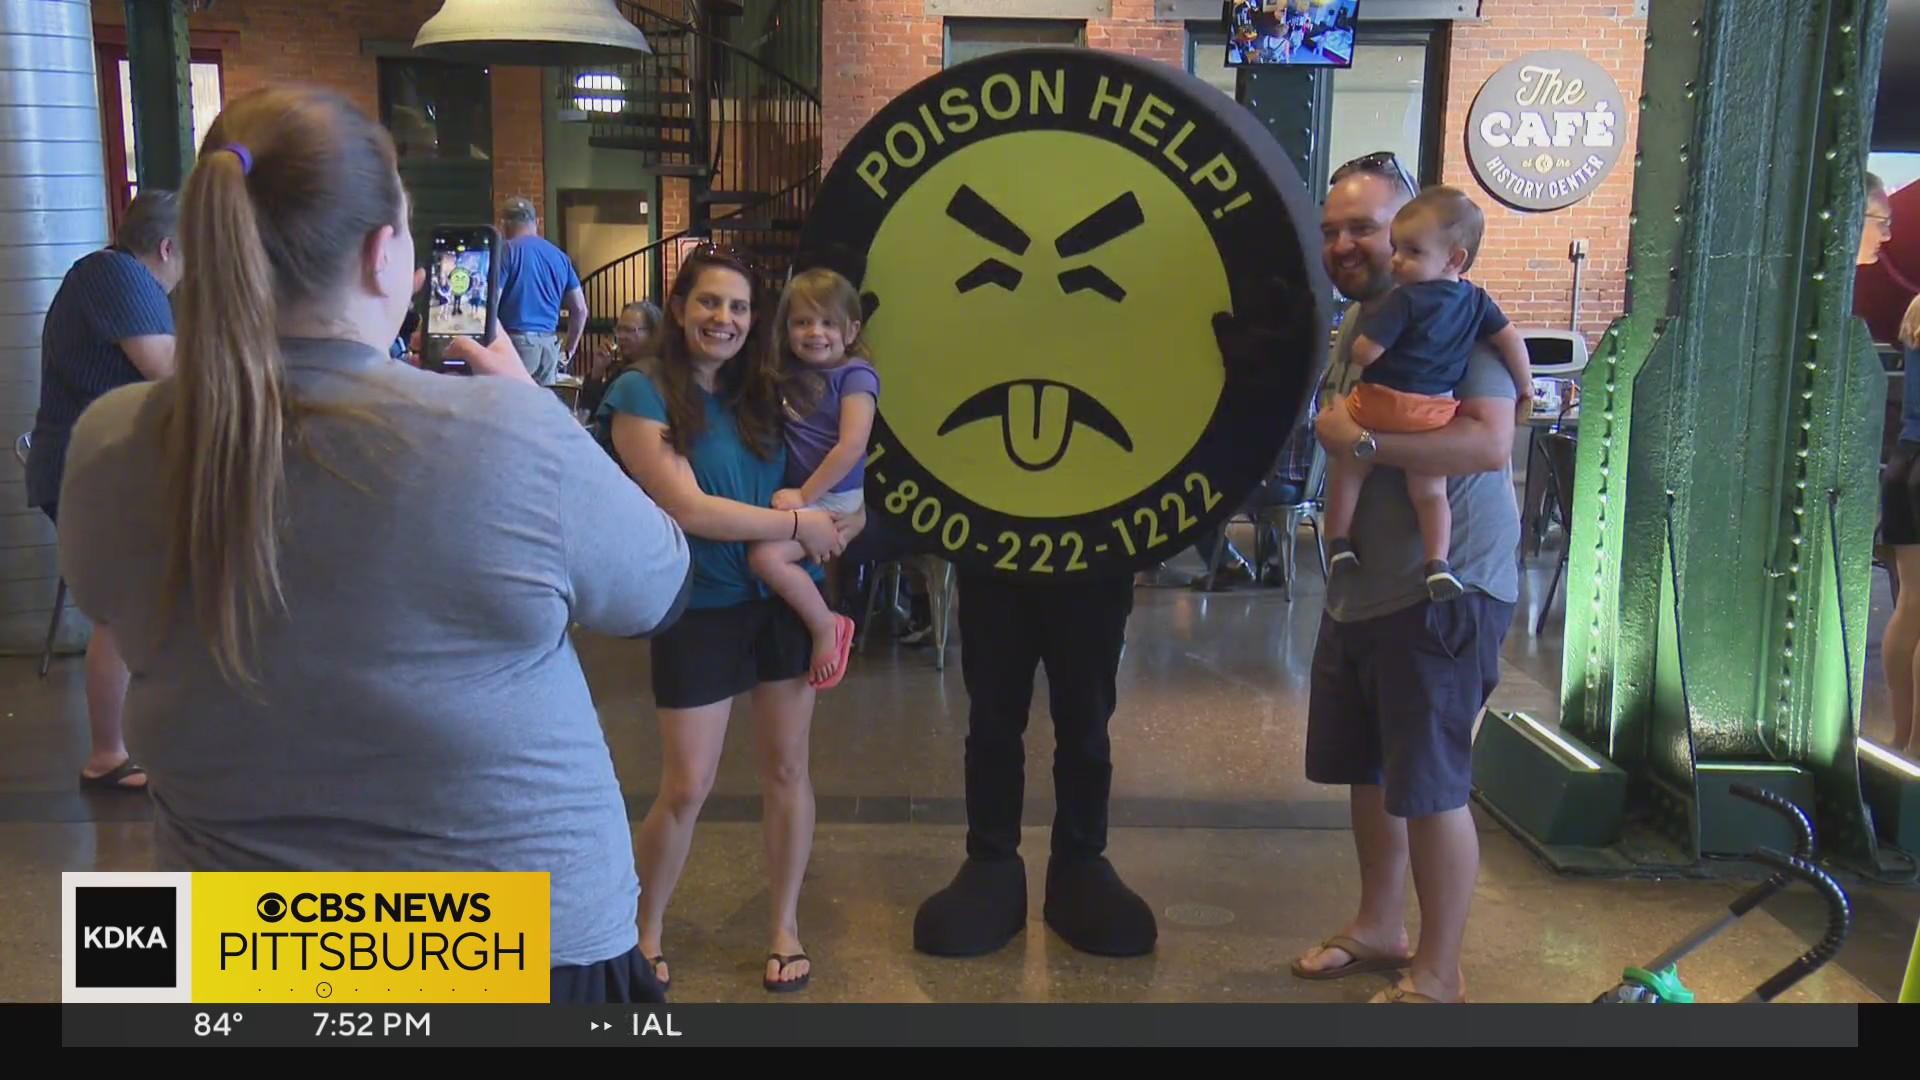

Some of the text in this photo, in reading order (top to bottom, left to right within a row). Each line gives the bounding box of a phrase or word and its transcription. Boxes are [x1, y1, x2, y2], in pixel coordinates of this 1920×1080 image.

[1515, 65, 1586, 106] The
[856, 69, 1253, 219] POISON HELP!
[1480, 100, 1615, 148] CAFÉ
[1486, 154, 1605, 199] HISTORY CENTER
[864, 443, 1224, 573] 1-800-222-1222
